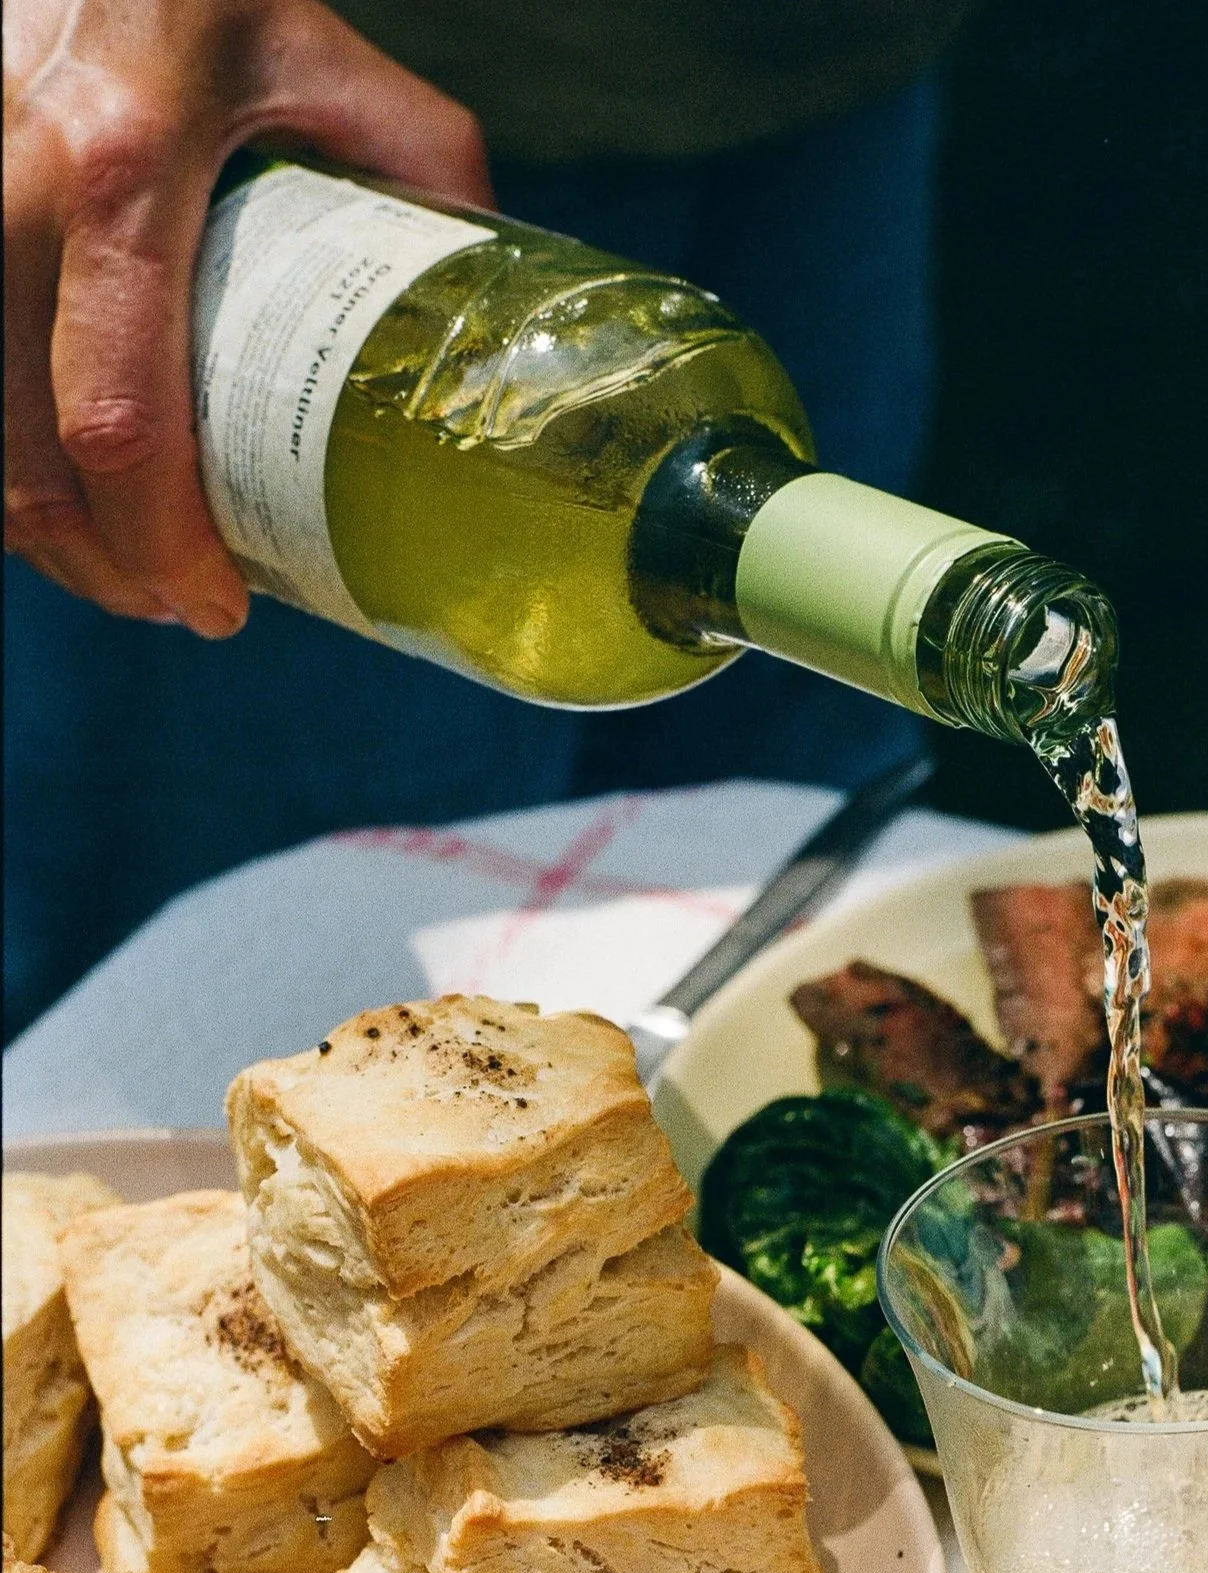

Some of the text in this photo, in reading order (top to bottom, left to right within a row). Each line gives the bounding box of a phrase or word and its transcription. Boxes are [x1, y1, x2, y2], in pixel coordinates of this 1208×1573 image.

[331, 256, 374, 300] 2021
[290, 263, 391, 462] Grüner Veltliner
